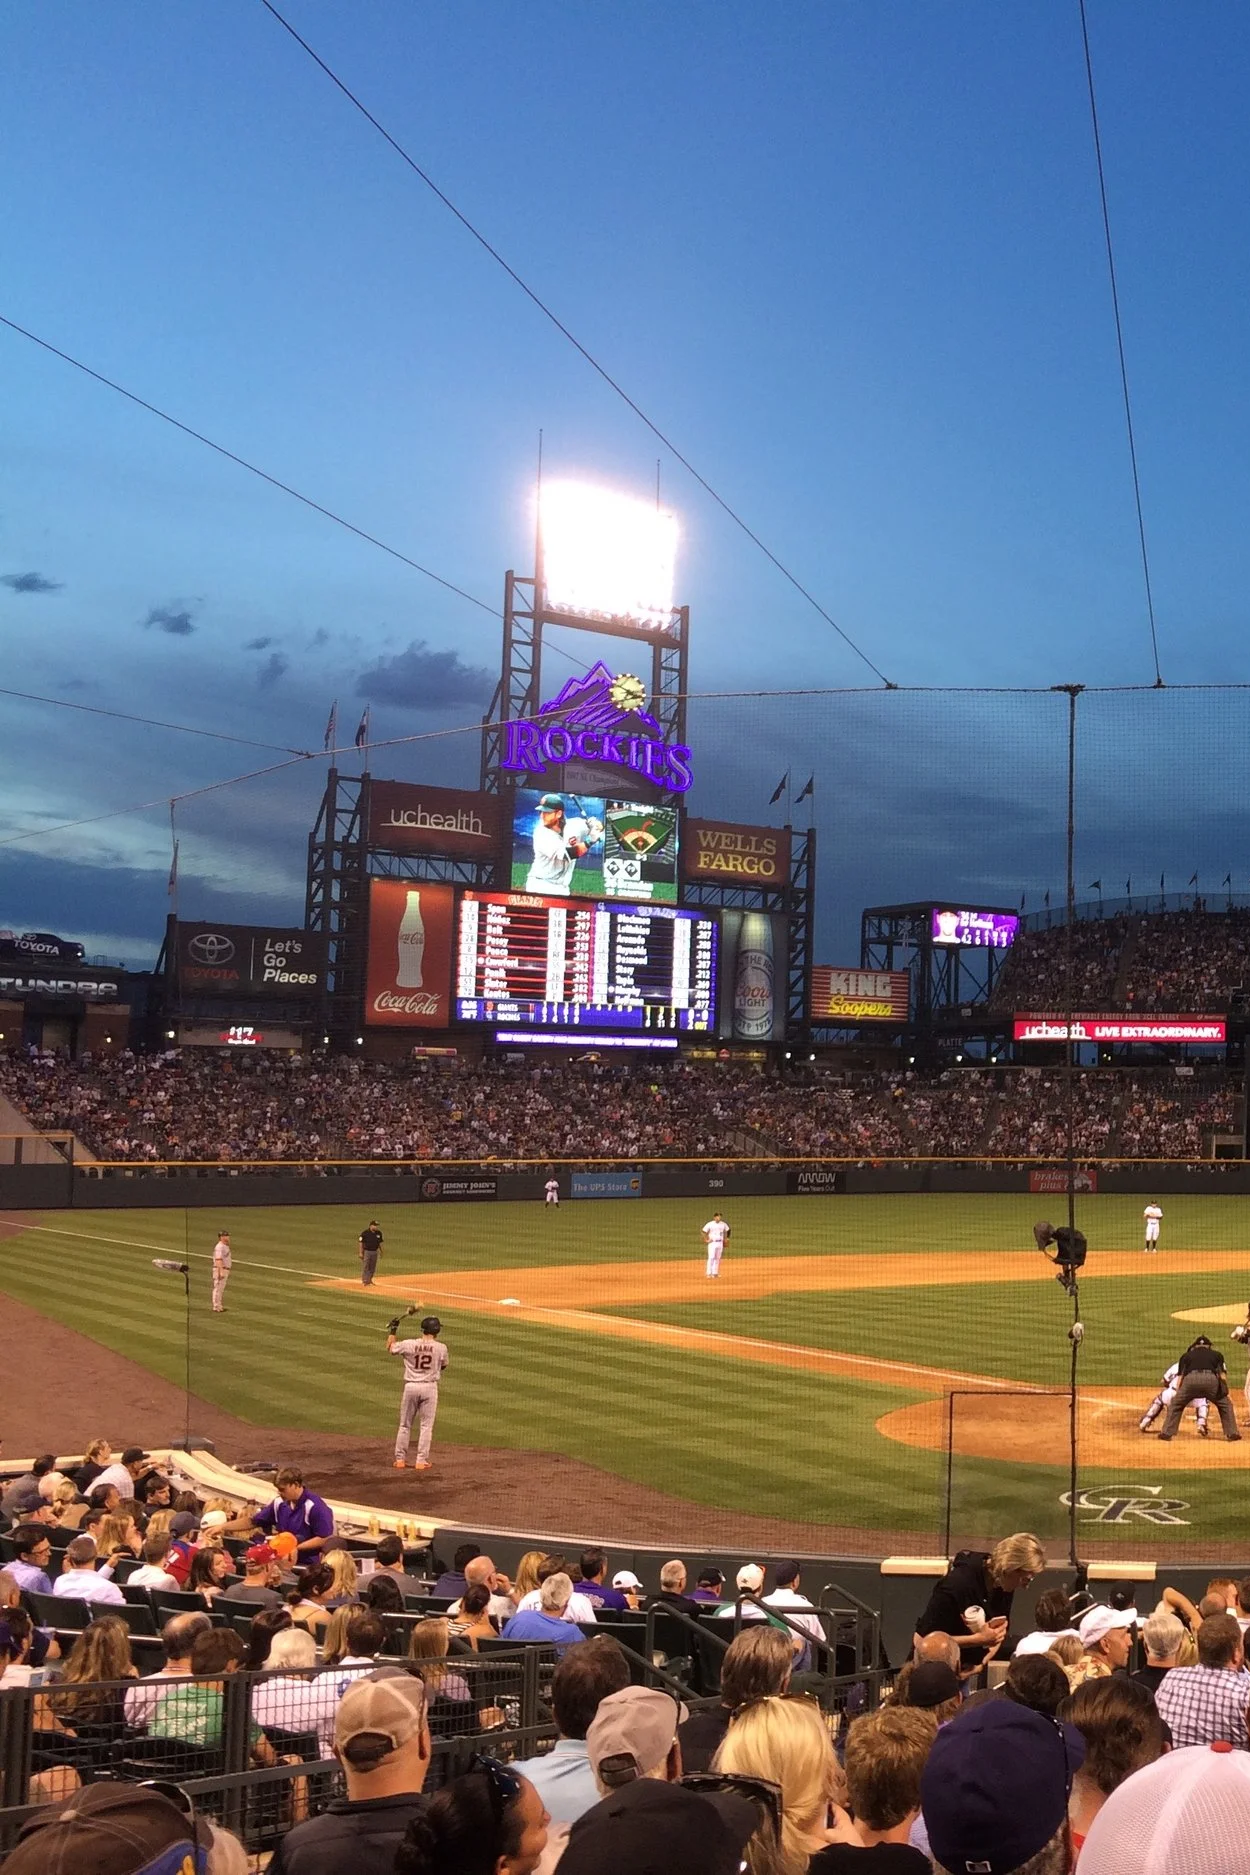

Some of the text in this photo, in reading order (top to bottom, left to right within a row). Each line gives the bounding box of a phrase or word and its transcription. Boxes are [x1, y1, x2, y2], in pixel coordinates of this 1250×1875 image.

[501, 719, 694, 793] ROCKIES
[390, 804, 482, 834] uchealth
[696, 829, 777, 856] WELLS
[697, 850, 776, 876] FARGO
[13, 939, 60, 955] TOYOTA
[264, 938, 302, 953] Let's
[263, 953, 287, 967] Go
[183, 966, 240, 980] TOYOTA
[263, 969, 317, 984] Places
[0, 977, 118, 996] TUNDRA
[830, 972, 893, 998] KING
[373, 990, 443, 1016] Coca-Cola
[827, 995, 893, 1020] Soopers
[1025, 1022, 1222, 1038] ucheath LIVE EXTRAORDINARY.
[798, 1172, 836, 1184] ARROW
[1034, 1170, 1069, 1180] brakes
[574, 1183, 627, 1192] The UPS Store
[708, 1180, 724, 1188] 390
[1040, 1180, 1062, 1192] plus
[414, 1346, 434, 1354] PANIK
[414, 1354, 433, 1370] 12
